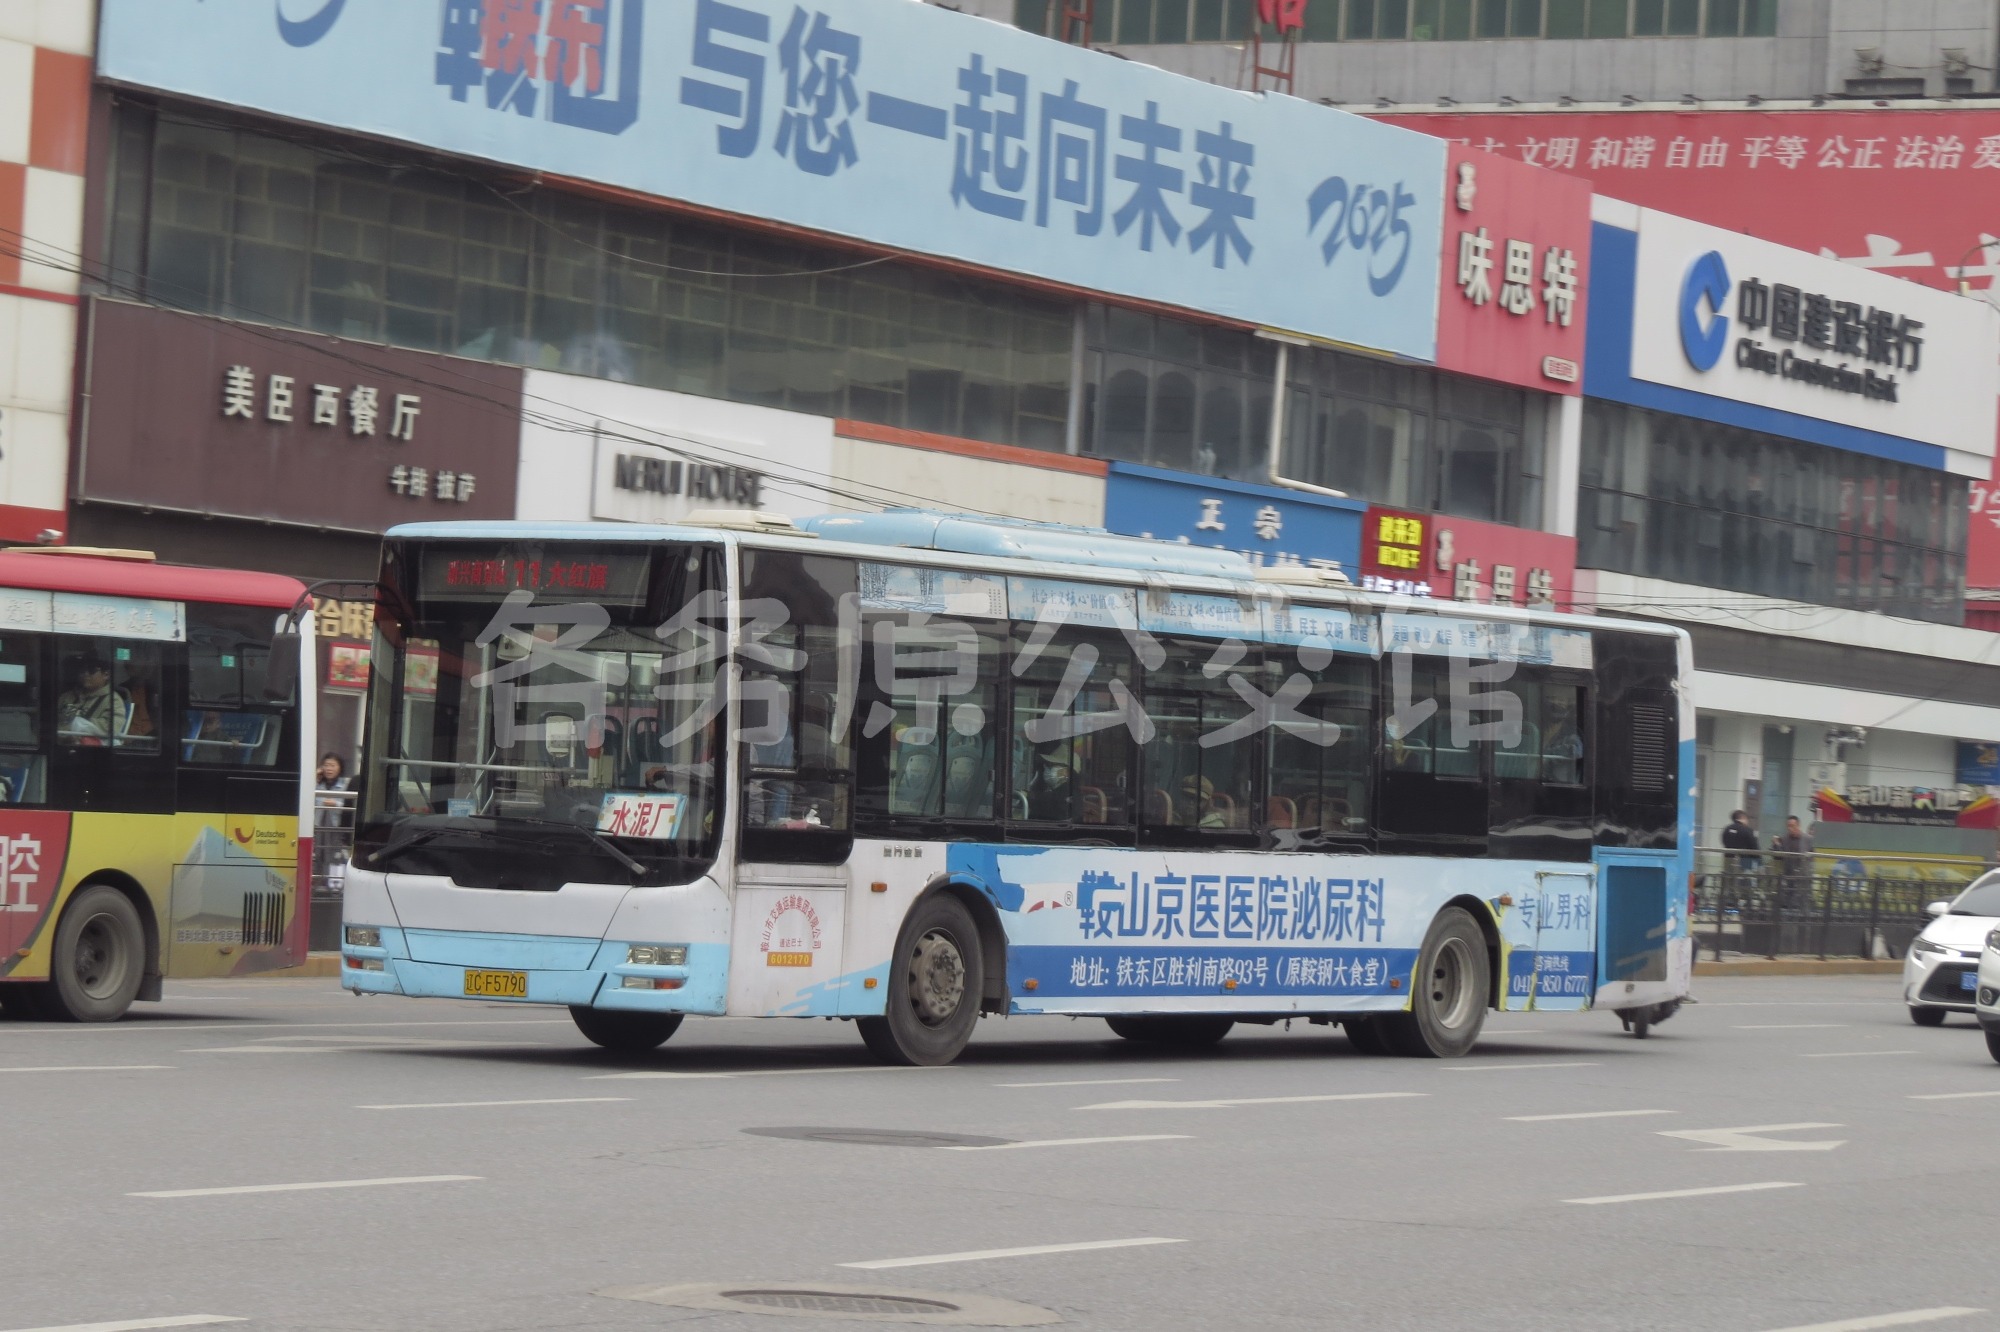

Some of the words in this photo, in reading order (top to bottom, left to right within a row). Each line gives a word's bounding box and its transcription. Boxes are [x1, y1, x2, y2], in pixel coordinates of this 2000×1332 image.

[679, 0, 1256, 270] 与您一起向未来
[1516, 136, 1580, 169] 文明
[1588, 136, 1657, 169] 和谐
[1664, 136, 1729, 168] 自由
[1739, 136, 1809, 169] 平等
[1815, 135, 1887, 169] 公正
[1894, 135, 1966, 169] 法治
[1457, 226, 1578, 327] 味思特
[1739, 277, 1925, 373] 中国建设银行
[224, 365, 421, 441] 美臣西餐厅
[391, 465, 428, 497] 牛排
[436, 470, 476, 502] 披萨
[608, 800, 675, 837] 水泥厂
[1076, 869, 1385, 943] 鞍山京医医院泌尿科
[1518, 893, 1592, 931] 专业男科
[770, 954, 810, 965] 6012170
